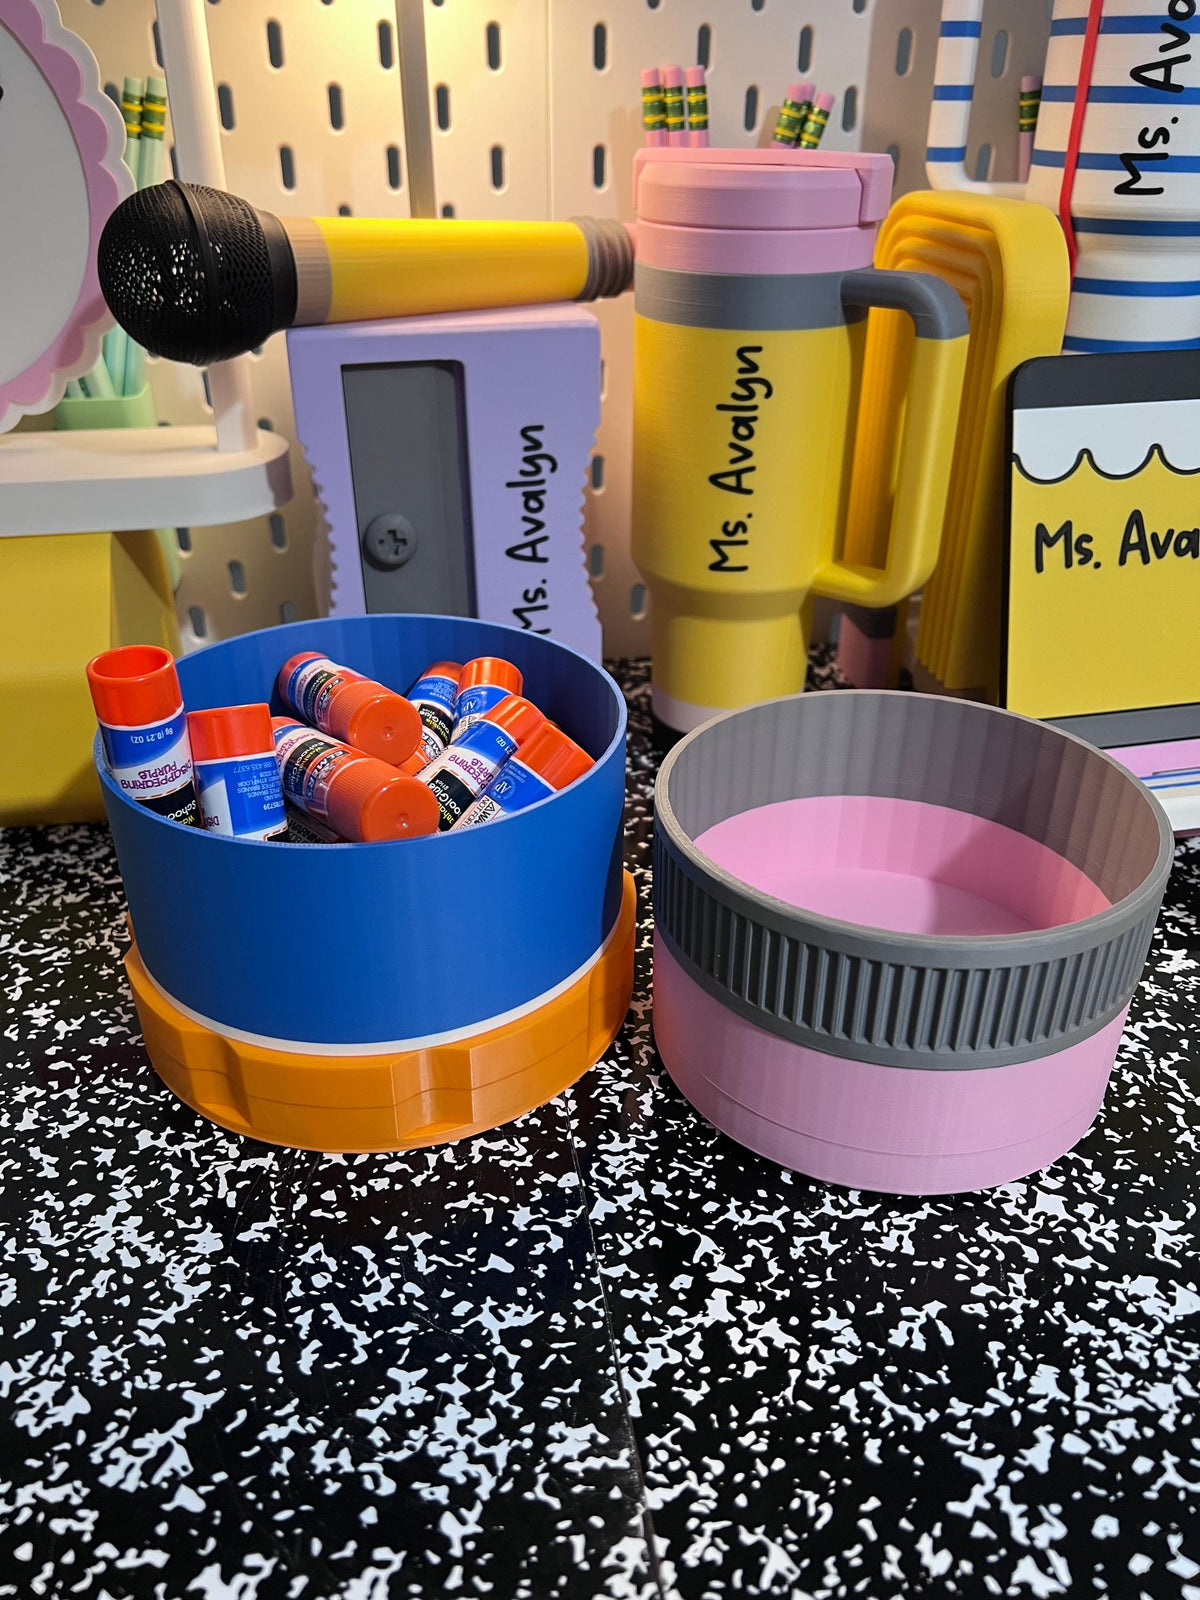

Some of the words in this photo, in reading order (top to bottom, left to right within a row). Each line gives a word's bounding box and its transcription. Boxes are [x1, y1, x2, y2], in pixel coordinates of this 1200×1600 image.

[1114, 116, 1178, 195] Ms.
[708, 346, 773, 495] Avalyn
[505, 424, 558, 563] Avalyn
[708, 513, 753, 572] Ms.
[1035, 520, 1102, 574] Ms.
[1118, 509, 1200, 567] Ava
[512, 578, 552, 635] Ms.
[237, 785, 260, 793] BRANDS
[428, 783, 449, 802] Glue
[495, 781, 512, 794] AP
